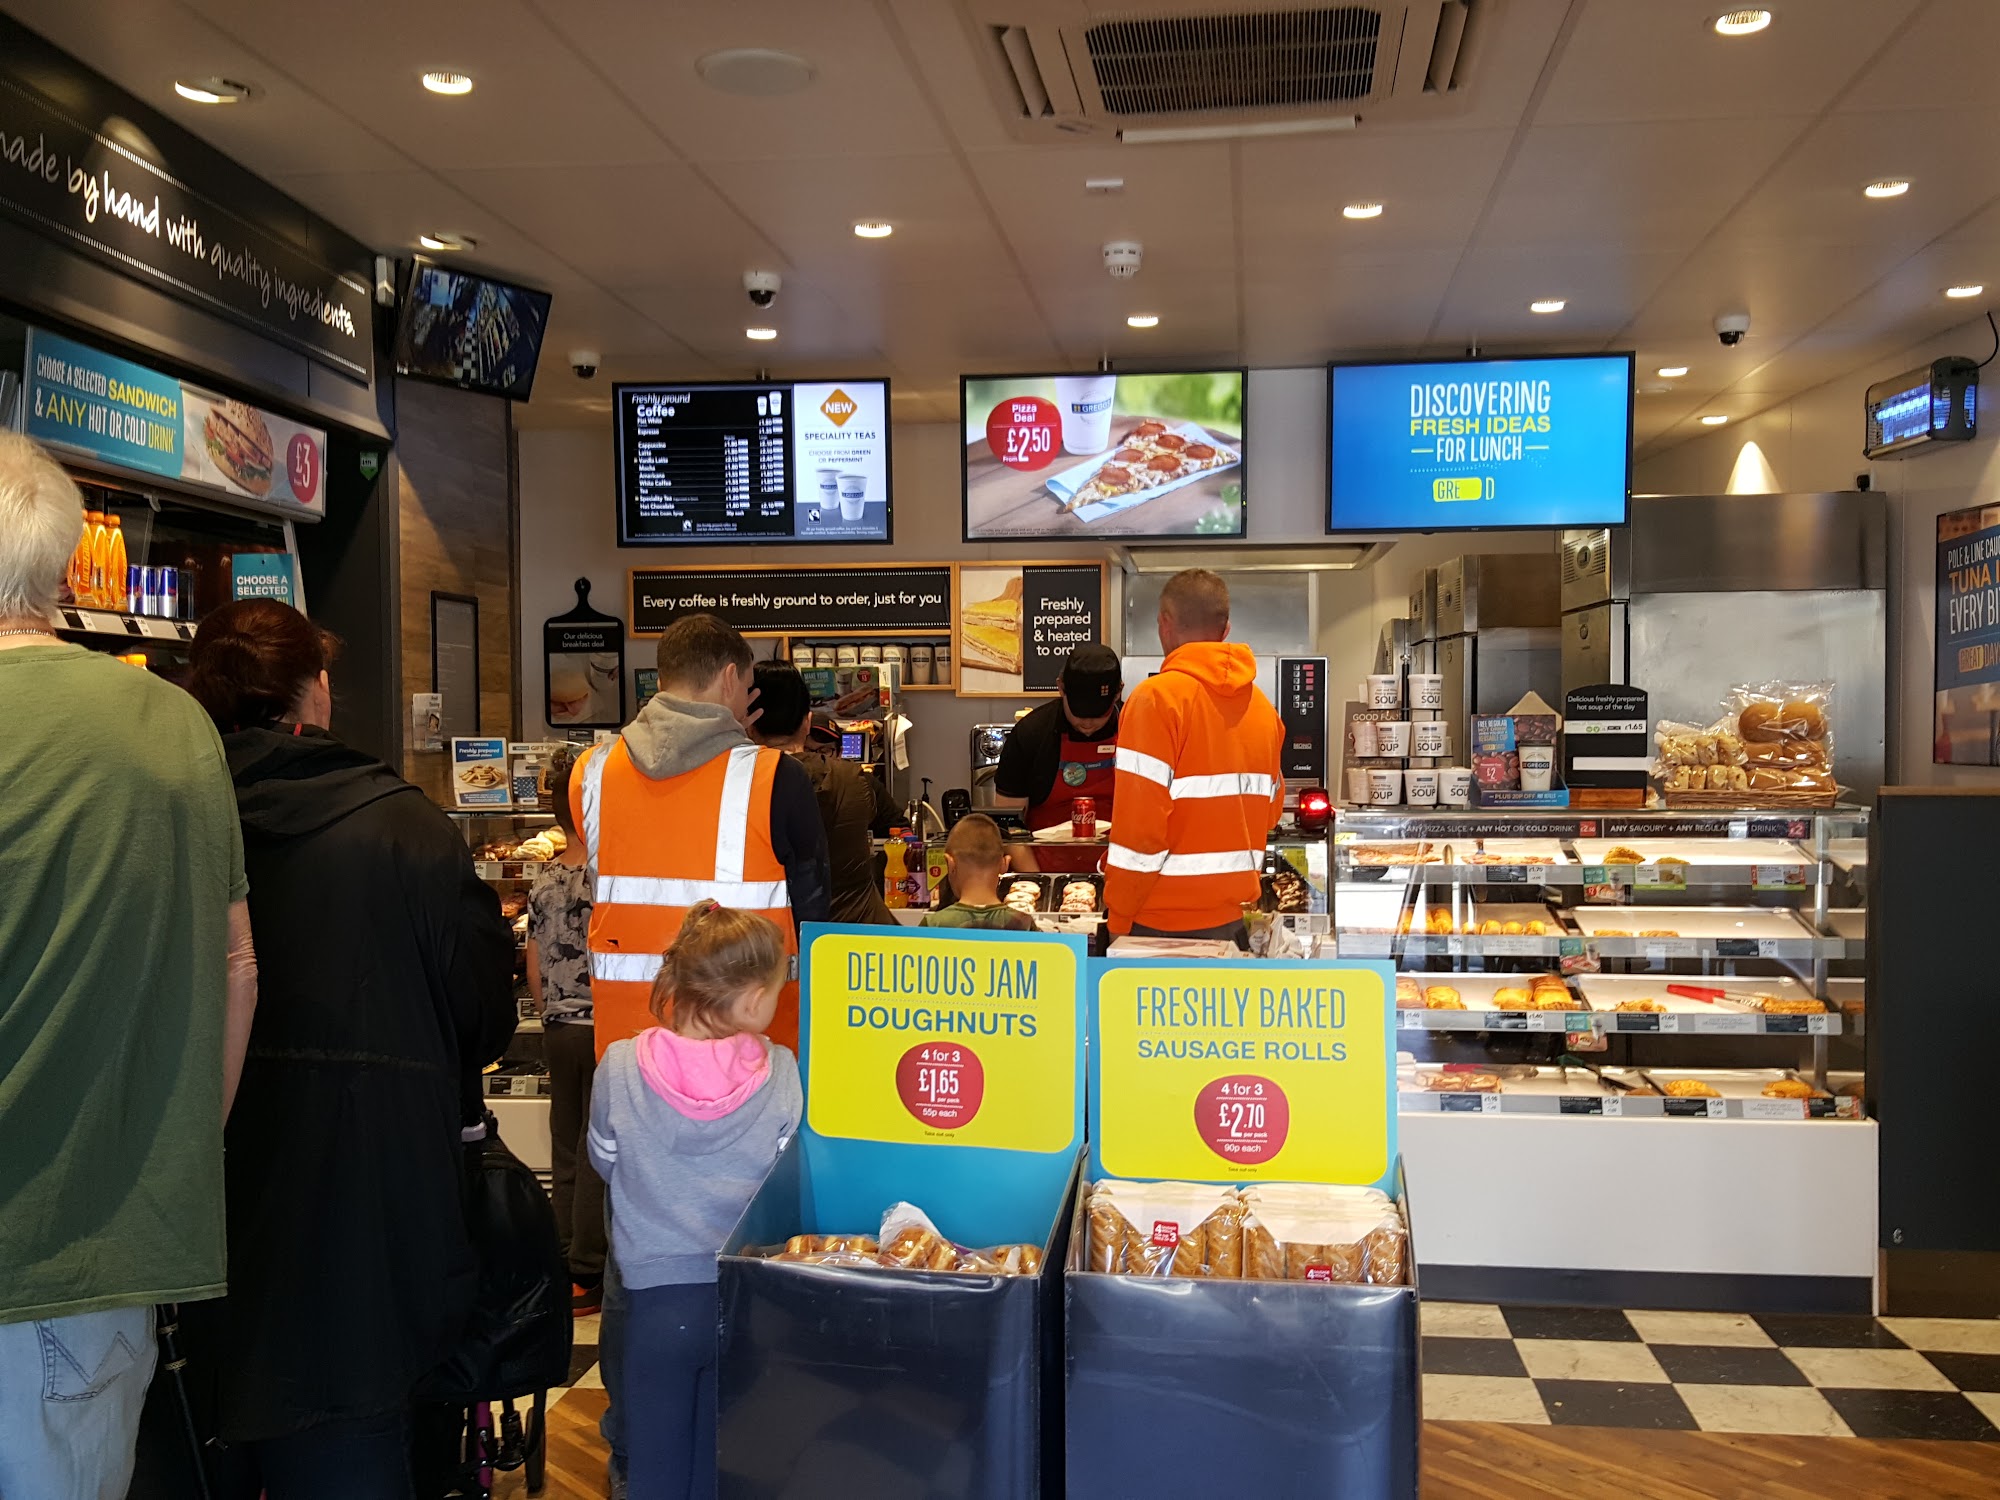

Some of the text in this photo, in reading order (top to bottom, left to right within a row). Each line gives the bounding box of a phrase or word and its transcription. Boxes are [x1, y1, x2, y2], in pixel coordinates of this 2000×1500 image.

[67, 155, 100, 224] by
[103, 170, 160, 238] hand
[166, 214, 206, 259] with
[211, 242, 270, 309] quality
[36, 353, 177, 419] CHOOSE A SELECTED SANDWICH
[631, 391, 691, 406] Freshly ground
[1410, 380, 1551, 418] DISCOVERING
[637, 404, 676, 417] Coffee
[825, 402, 853, 414] NEW
[1011, 403, 1037, 414] Pizza
[34, 387, 43, 418] &
[46, 391, 87, 428] ANY
[88, 403, 107, 436] HOT
[109, 410, 122, 441] OR
[124, 413, 146, 446] COLD
[1013, 412, 1036, 423] Deal
[1410, 415, 1551, 436] FRESH IDEAS
[804, 431, 876, 441] SPECIALITY TEAS
[1006, 426, 1050, 463] £2.50
[1436, 435, 1523, 463] FOR LUNCH
[296, 441, 311, 488] £3
[1002, 455, 1018, 464] From
[1485, 477, 1495, 500] D
[1948, 548, 1963, 570] POLE
[1964, 545, 1970, 565] &
[1970, 540, 1985, 563] LINE
[236, 575, 288, 586] CHOOSE A
[1949, 562, 1991, 595] TUNA
[236, 585, 288, 596] SELECTED
[642, 590, 942, 610] Every coffee is freshly ground to order, just for you
[1040, 597, 1085, 613] Freshly
[1950, 589, 2000, 635] EVERY BI
[1033, 611, 1091, 629] prepared
[563, 632, 603, 640] Our delicious
[1033, 628, 1091, 643] & heated
[562, 640, 605, 648] breakfast deal
[1036, 643, 1076, 656] to ord
[1960, 647, 1981, 670] GREAT
[1375, 695, 1397, 704] SOUP
[1421, 695, 1440, 704] SOU
[1567, 694, 1645, 704] Delicious freshly prepared
[1588, 704, 1603, 712] soup
[1623, 703, 1636, 712] day
[1352, 713, 1379, 721] GOOD
[1477, 719, 1488, 728] FREE
[1292, 742, 1312, 750] MONO
[1380, 743, 1399, 752] OUP
[1417, 743, 1442, 752] SOUP
[1486, 767, 1497, 780] £2
[1411, 788, 1436, 797] SOUP
[1450, 788, 1468, 797] SOU
[1406, 825, 1423, 833] ANY
[1447, 825, 1467, 833] SLICE
[1525, 824, 1548, 832] COLD
[1675, 824, 1693, 832] ANY
[1694, 824, 1729, 832] REGULAR
[847, 951, 1038, 1000] DELICIOUS JAM
[1136, 986, 1346, 1029] FRESHLY BAKED
[847, 1004, 1038, 1037] DOUGHNUTS
[921, 1048, 961, 1062] 4 for 3
[1138, 1040, 1347, 1062] SAUSAGE ROLLS
[917, 1067, 960, 1103] £1.65
[1220, 1082, 1263, 1096] 4 for 3
[922, 1107, 958, 1118] 55p each
[1218, 1102, 1265, 1138] £2.70
[1224, 1143, 1262, 1153] 90p each
[1155, 1223, 1162, 1233] 4
[1169, 1231, 1177, 1243] 3
[1306, 1268, 1315, 1280] 4
